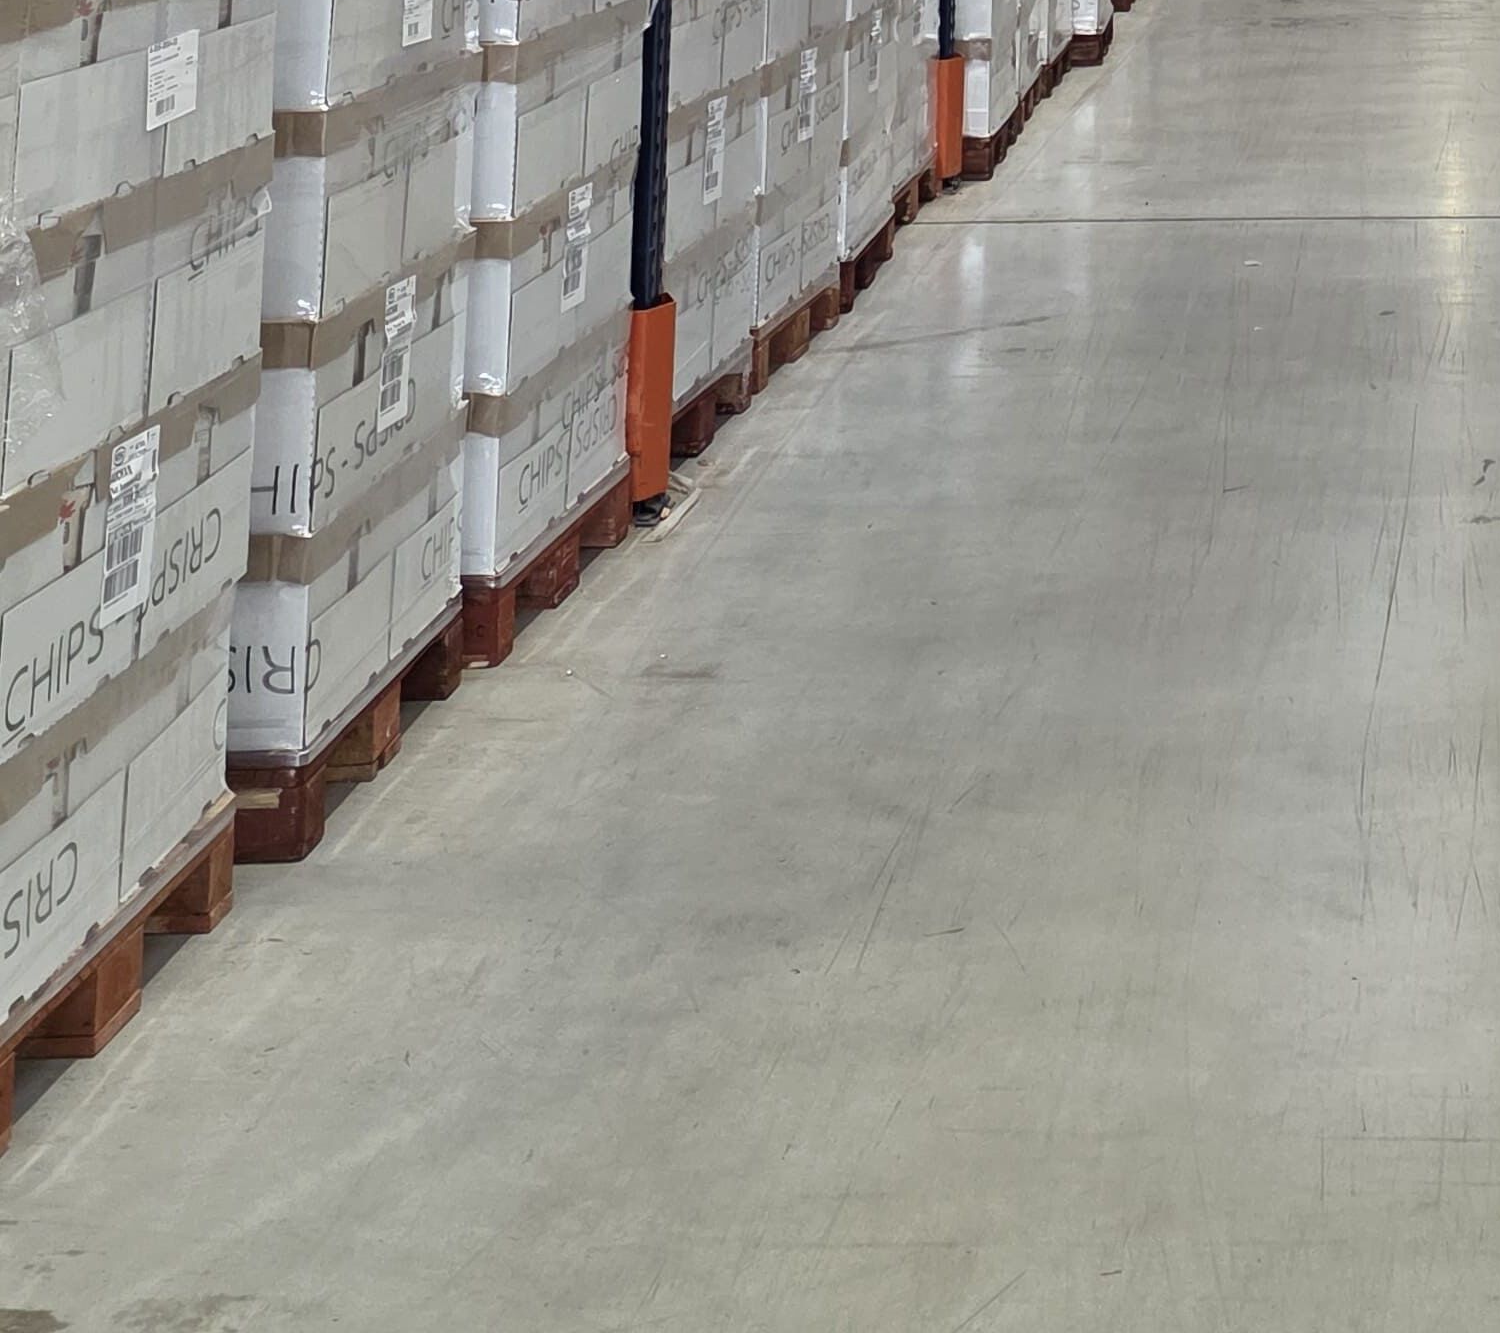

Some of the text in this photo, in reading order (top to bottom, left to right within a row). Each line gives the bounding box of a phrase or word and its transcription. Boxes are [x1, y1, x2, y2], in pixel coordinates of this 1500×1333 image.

[518, 433, 567, 506] CHIPS
[4, 605, 105, 733] CHIPS
[3, 842, 79, 961] CRIS
